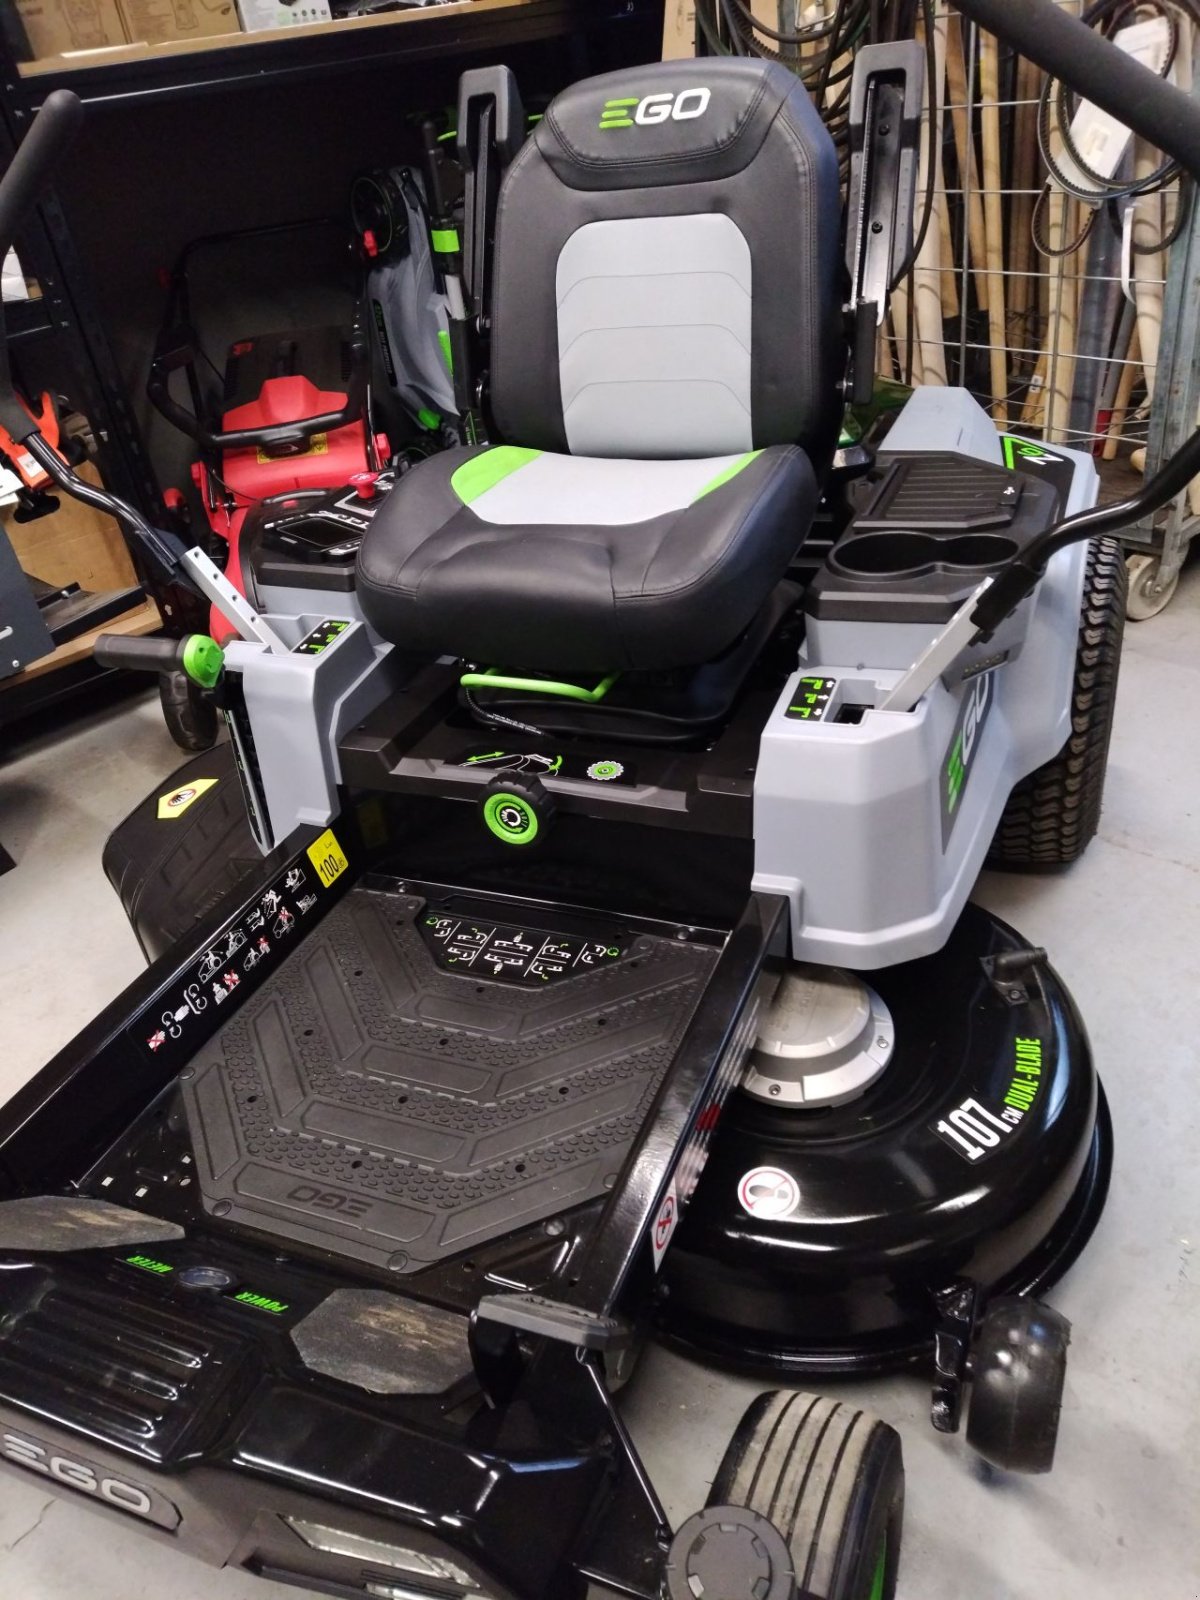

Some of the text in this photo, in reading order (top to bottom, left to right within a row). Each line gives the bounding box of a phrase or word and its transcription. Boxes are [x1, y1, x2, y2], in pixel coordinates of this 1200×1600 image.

[599, 88, 711, 128] EGO
[320, 854, 339, 882] 100
[938, 1097, 1013, 1160] 107
[1004, 1037, 1042, 1111] DUAL-BLADE
[286, 1185, 373, 1218] EGO
[126, 1255, 289, 1313] POWER METER
[3, 1433, 151, 1514] EGO
